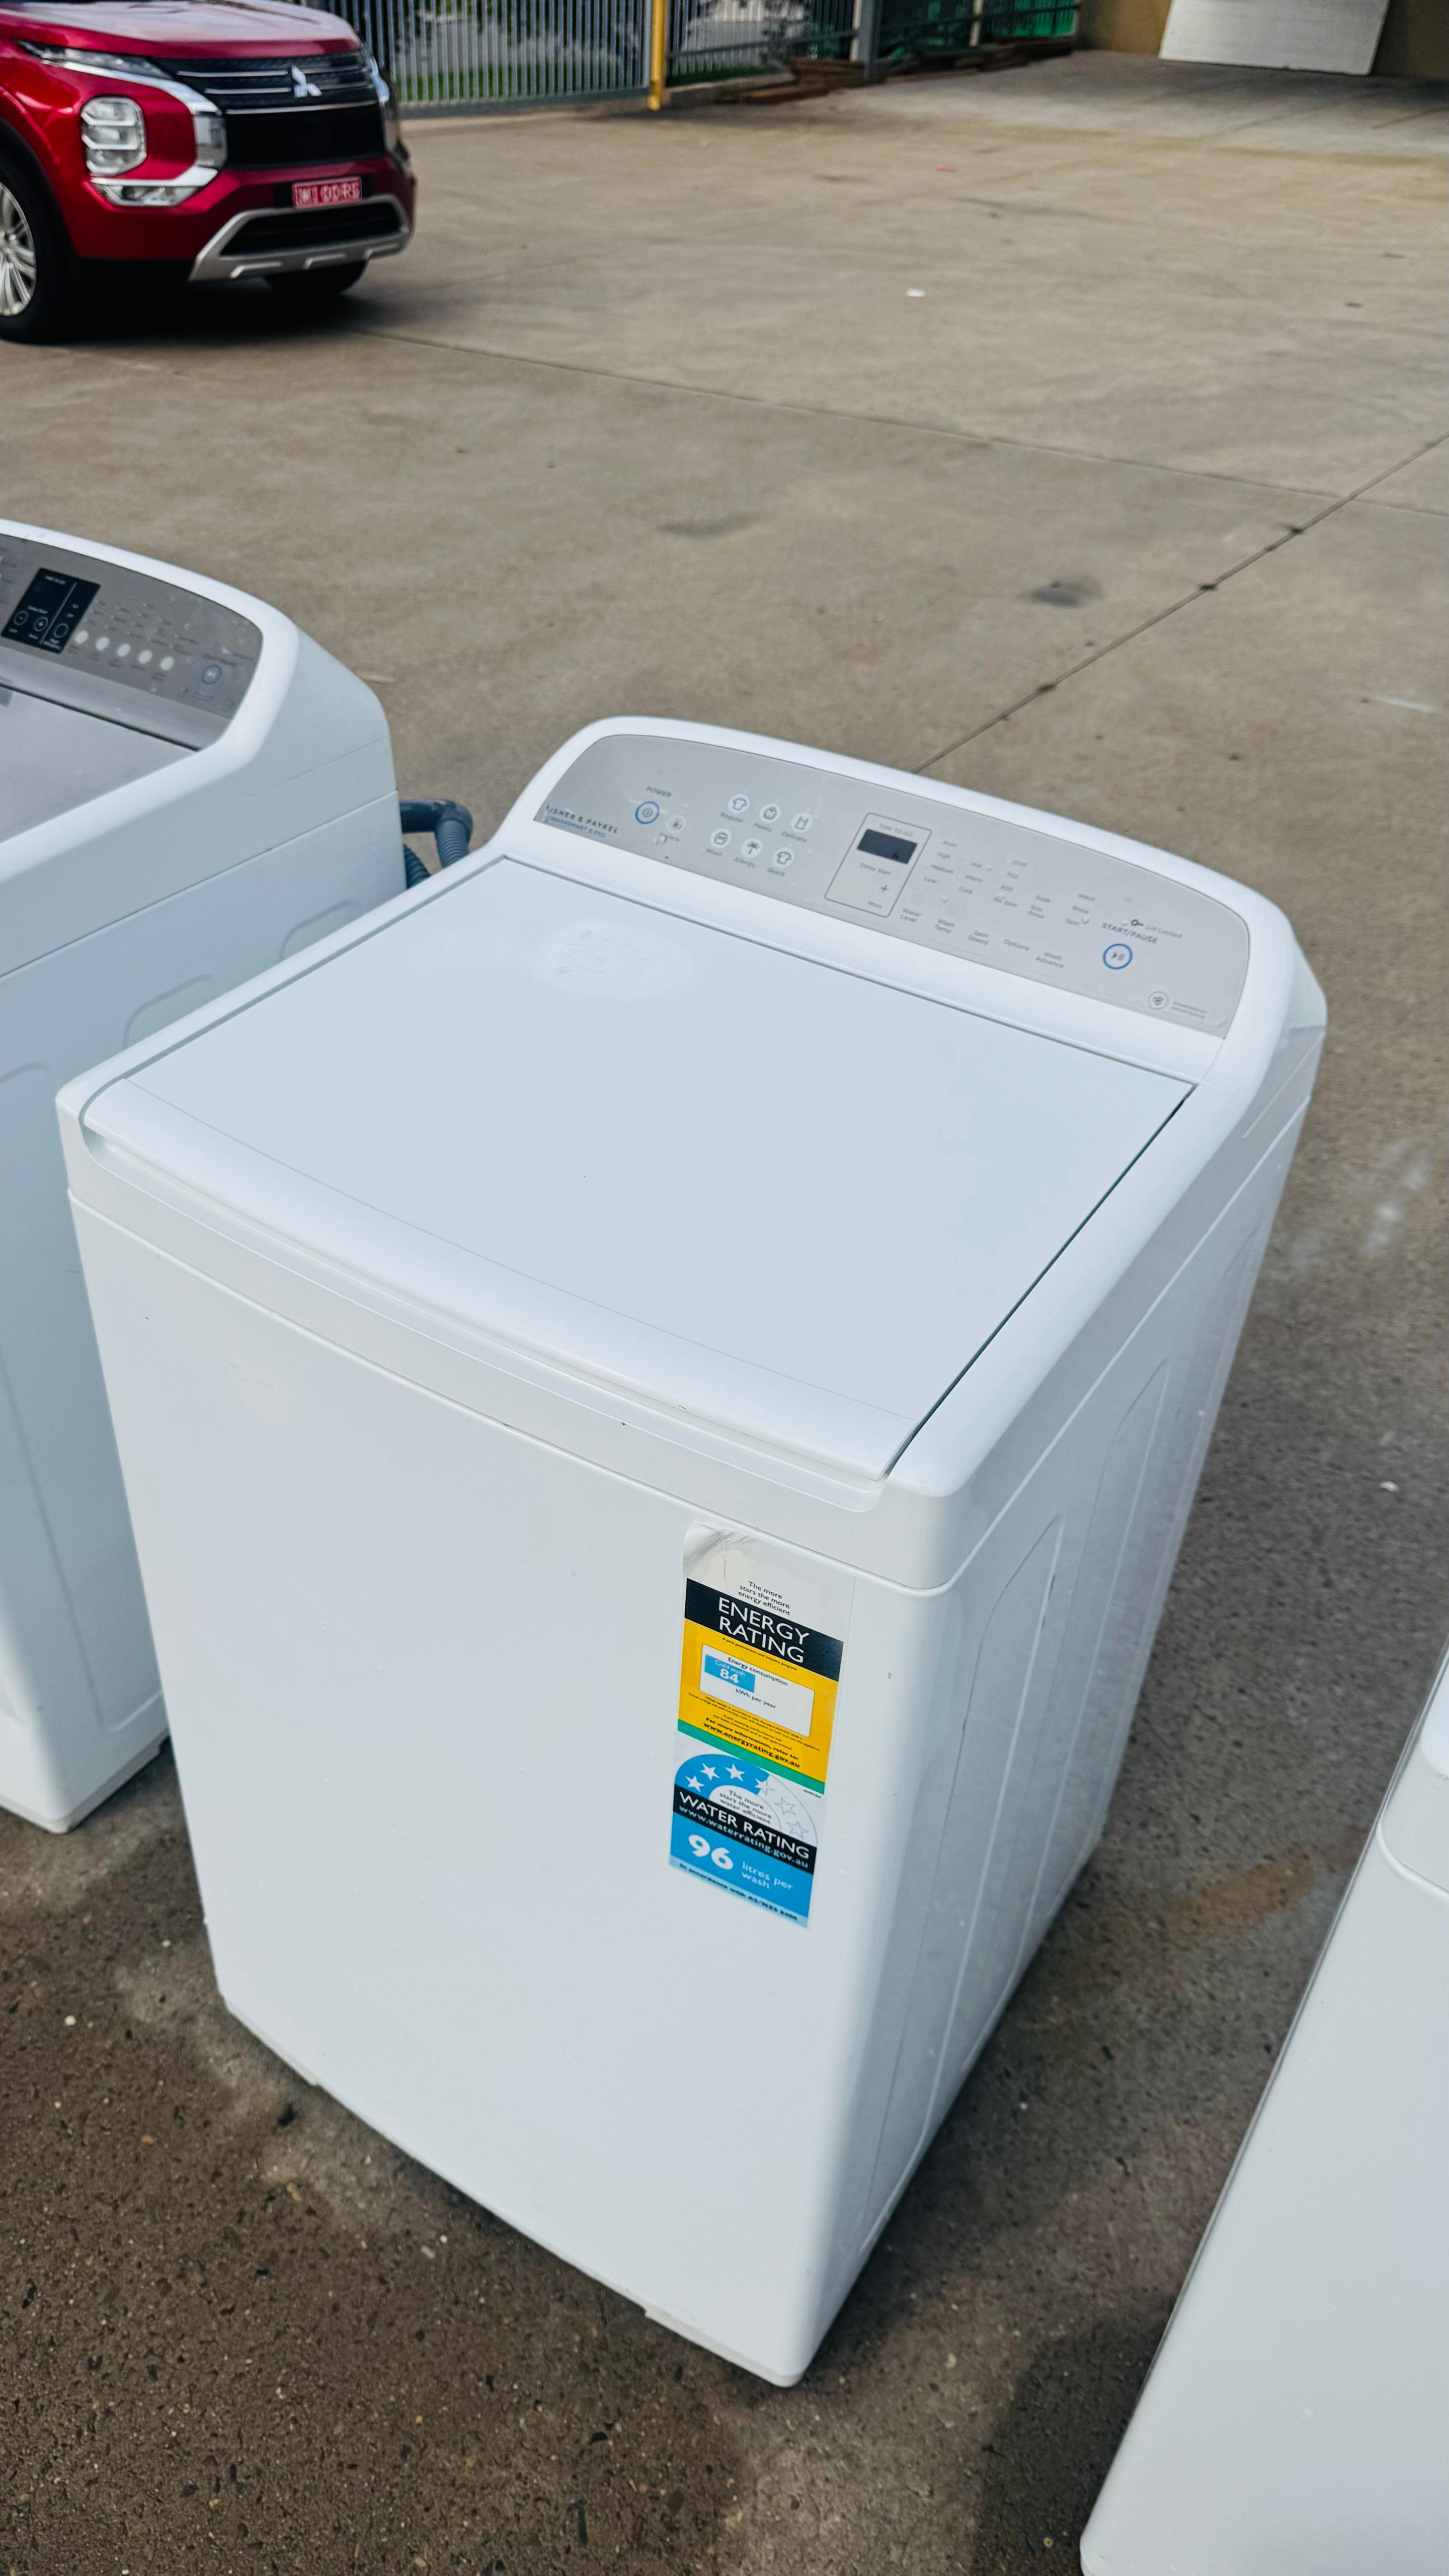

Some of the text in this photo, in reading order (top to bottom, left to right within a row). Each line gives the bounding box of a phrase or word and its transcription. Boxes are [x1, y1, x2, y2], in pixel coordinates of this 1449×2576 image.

[646, 786, 672, 798] POWER
[587, 819, 618, 834] PAYKEL
[734, 857, 755, 868] Allergy
[860, 862, 892, 876] Delay Start
[1101, 923, 1158, 944] START/PAUSE
[1004, 939, 1029, 951] Options
[740, 1585, 790, 1609] stars the more
[749, 1581, 782, 1599] The more
[738, 1591, 790, 1616] energy efficient
[718, 1596, 810, 1645] ENERGY
[719, 1616, 804, 1663] RATING
[715, 1660, 730, 1670] Cold
[719, 1668, 739, 1684] 84
[728, 1657, 788, 1686] Energy consumption
[736, 1688, 750, 1698] kWh
[763, 1701, 777, 1709] year
[703, 1722, 800, 1767] www.energyrating.gov.au
[717, 1723, 733, 1731] more
[735, 1730, 772, 1749] information,
[773, 1747, 788, 1755] refer
[719, 1793, 772, 1819] stars the more
[729, 1789, 764, 1809] The more
[720, 1799, 771, 1824] water efficient
[680, 1791, 810, 1859] WATER RATING
[679, 1805, 809, 1868] www.waterrating.gov.au
[688, 1834, 793, 1890] 96 litres per
[742, 1872, 770, 1889] wash
